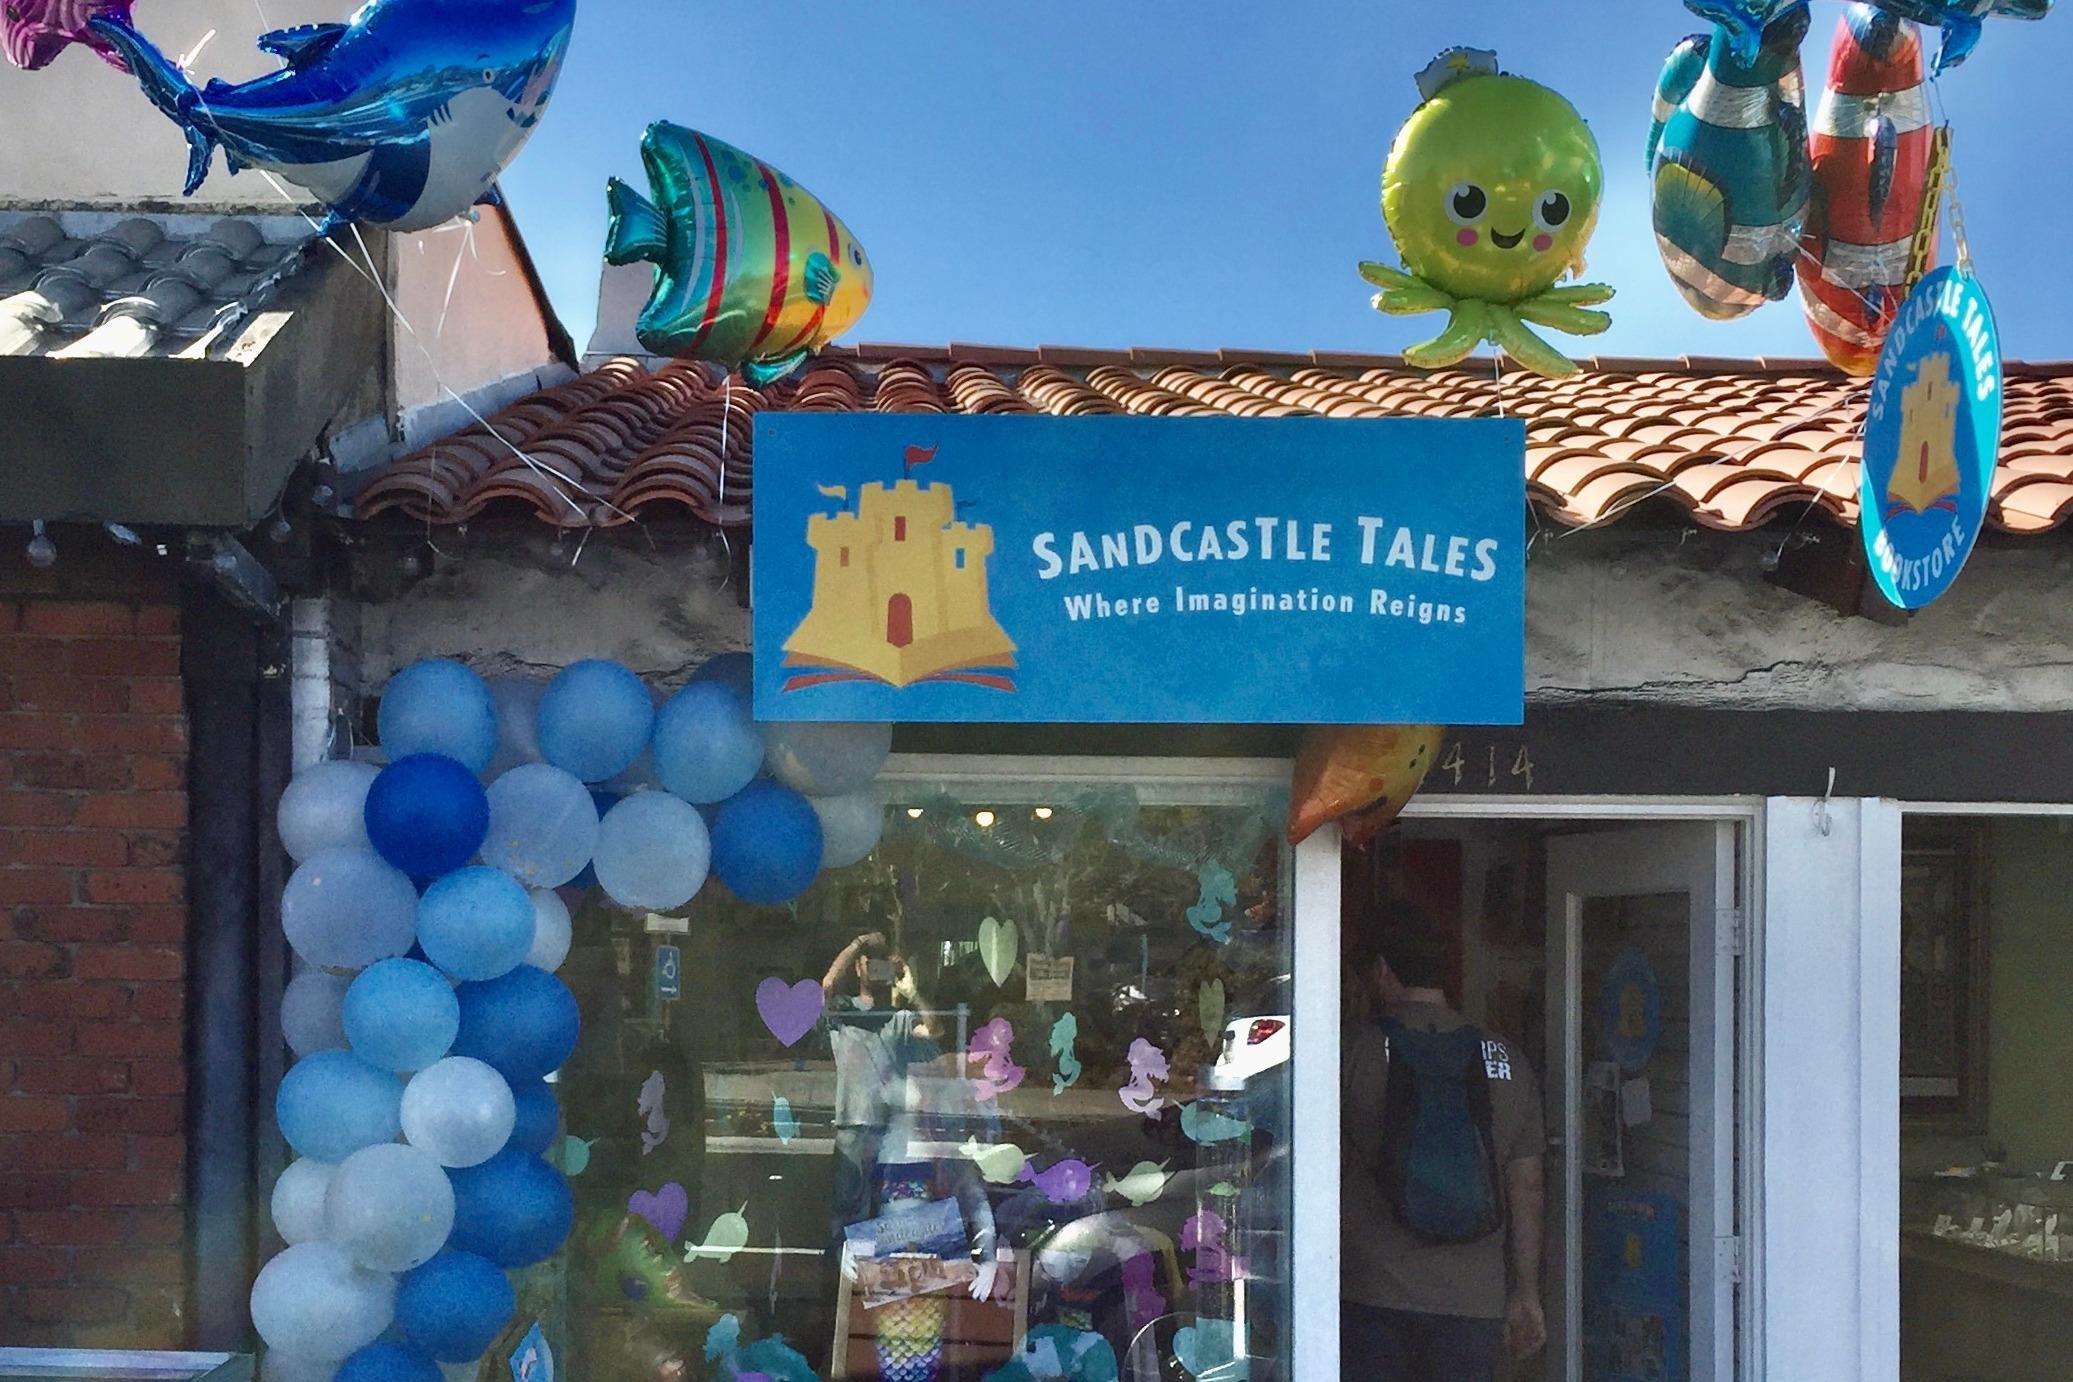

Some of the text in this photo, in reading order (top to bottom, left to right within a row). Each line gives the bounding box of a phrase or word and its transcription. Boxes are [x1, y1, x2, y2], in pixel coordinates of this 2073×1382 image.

[1872, 280, 1995, 421] SANDCASTLE TALES
[1032, 515, 1499, 582] SANDCASTLE TALES
[1873, 514, 1966, 592] BOOKSTORE
[1063, 585, 1467, 625] Where Imagination Reigns
